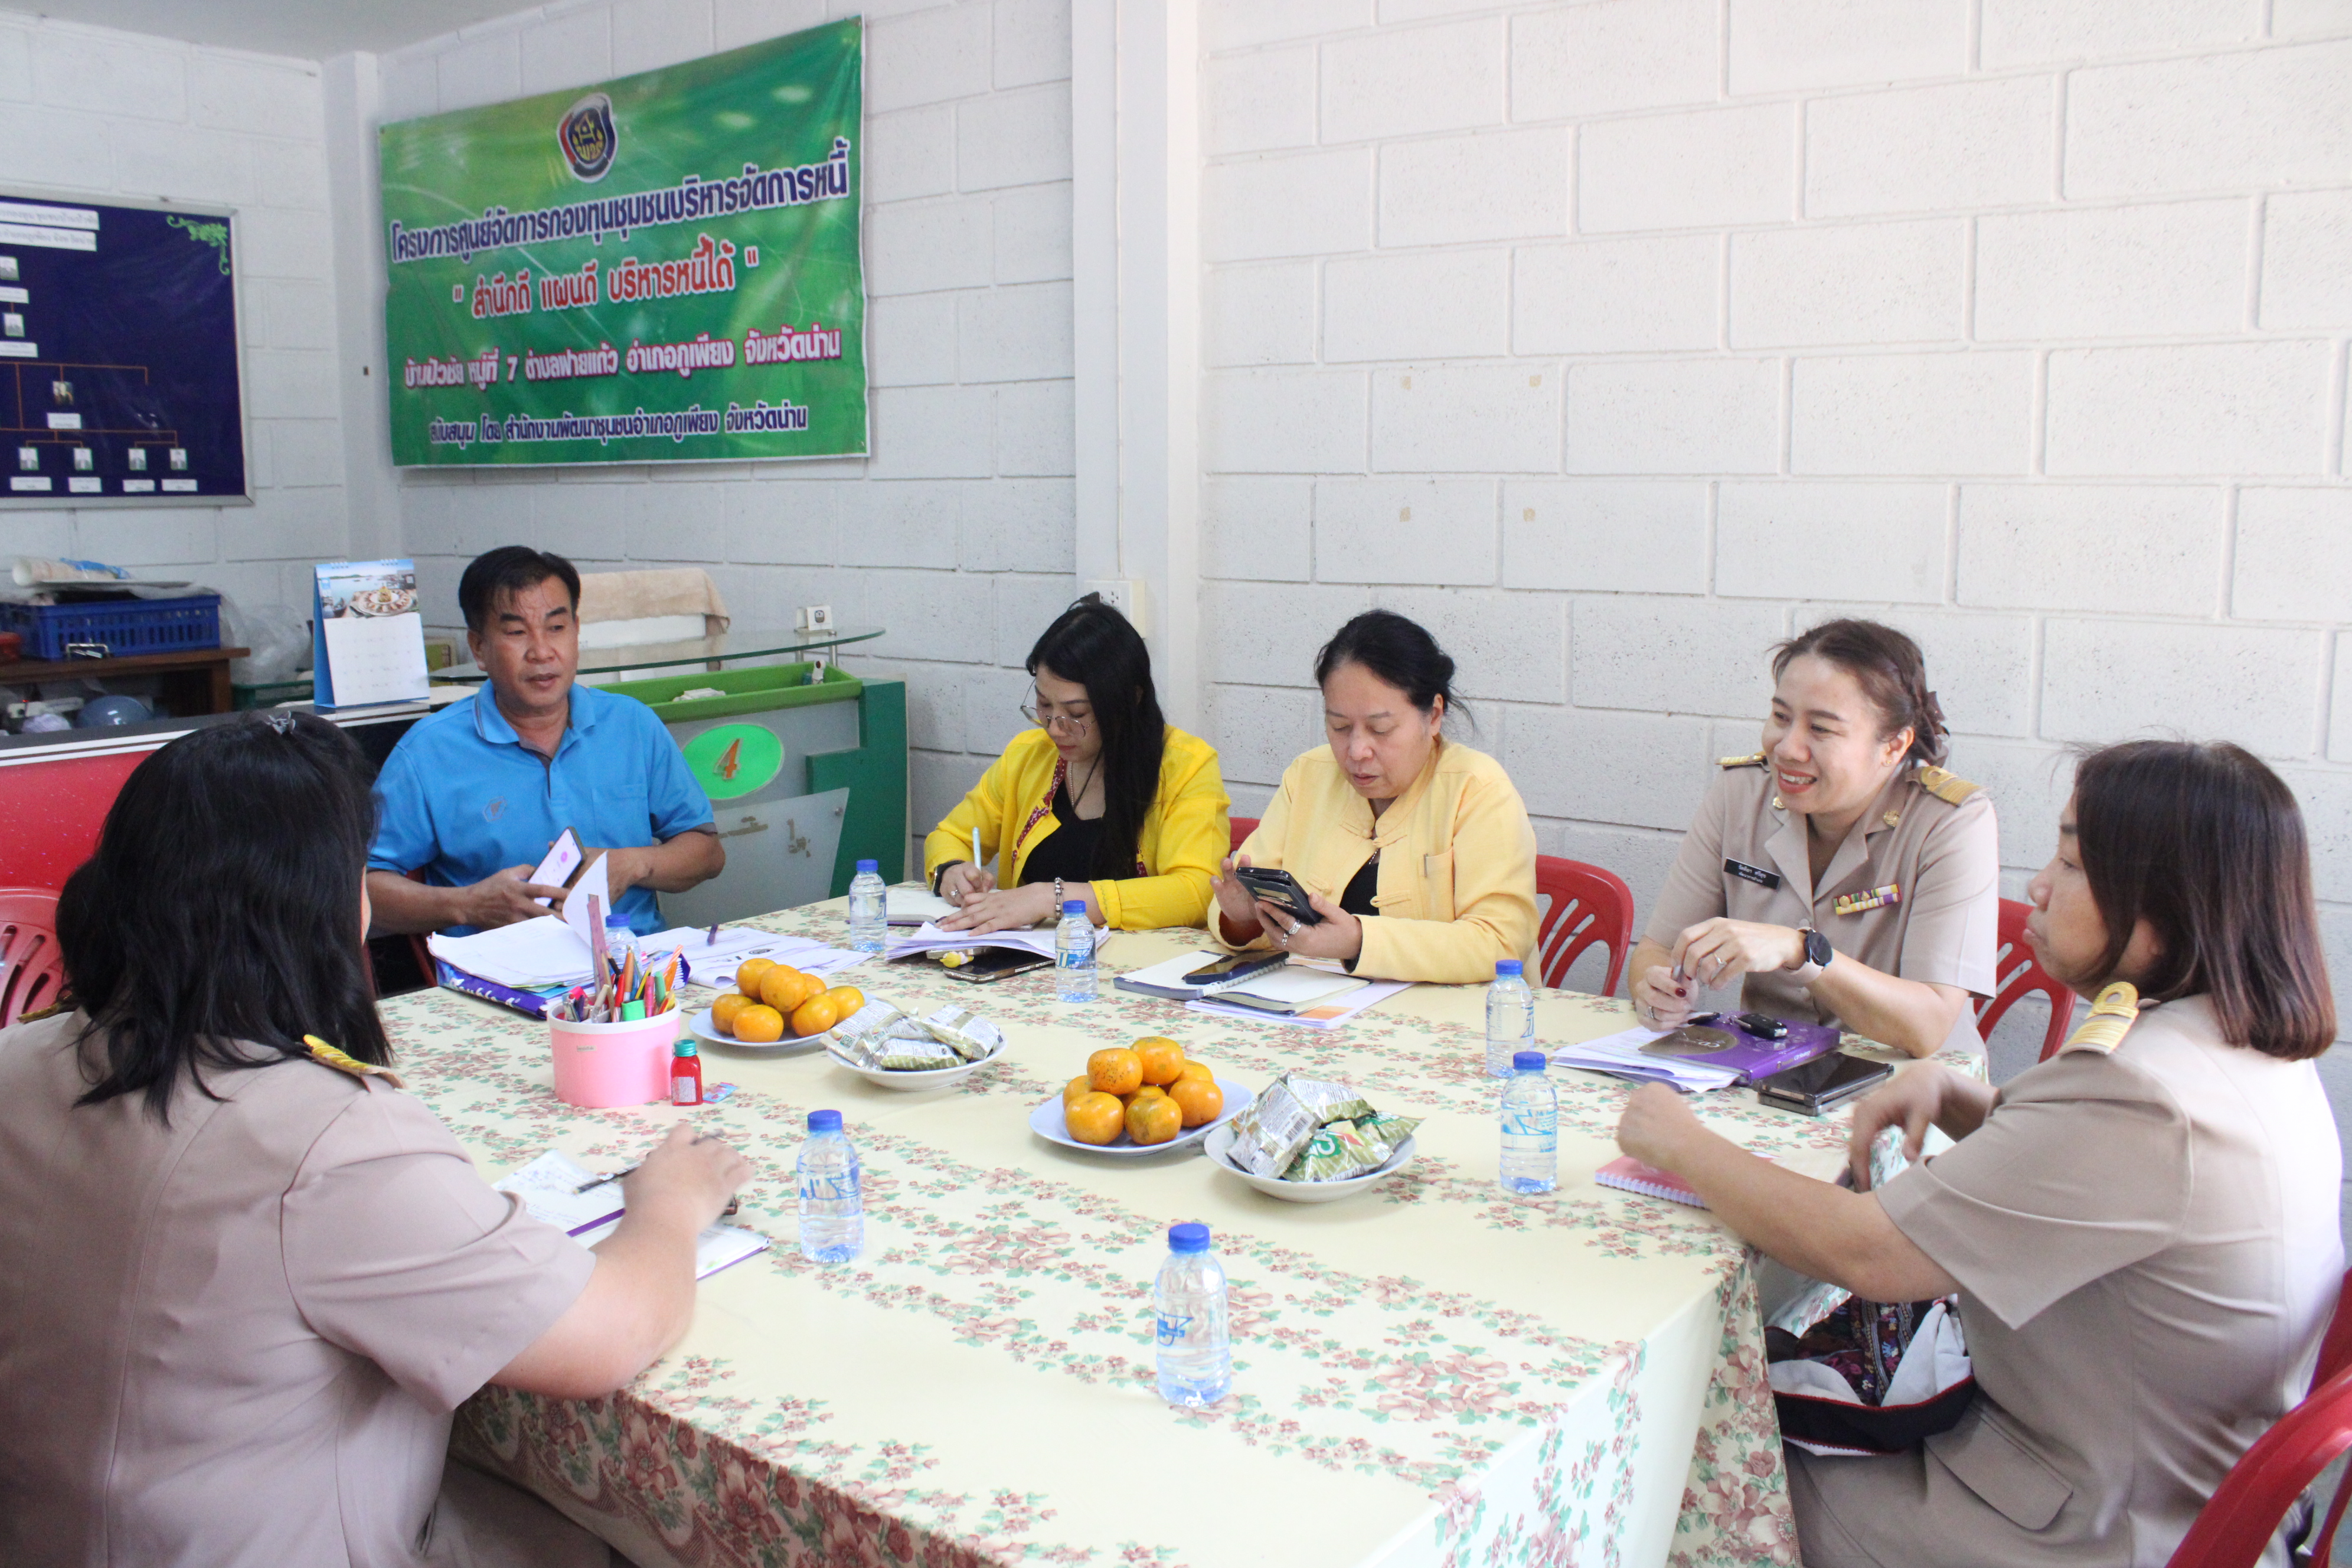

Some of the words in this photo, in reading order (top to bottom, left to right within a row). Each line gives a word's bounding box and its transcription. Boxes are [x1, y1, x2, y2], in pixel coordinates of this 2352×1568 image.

[540, 262, 598, 309] แผนดี
[609, 235, 734, 302] บริหารหนี้ได้
[508, 356, 517, 381] 7
[525, 342, 618, 381] ตำบลฝายแก้ว
[626, 332, 734, 377] อำเภอภูเพียง
[745, 323, 841, 364] จังหวัดน่าน
[481, 414, 502, 442] โดย
[726, 401, 807, 432] จังหวัดน่าน
